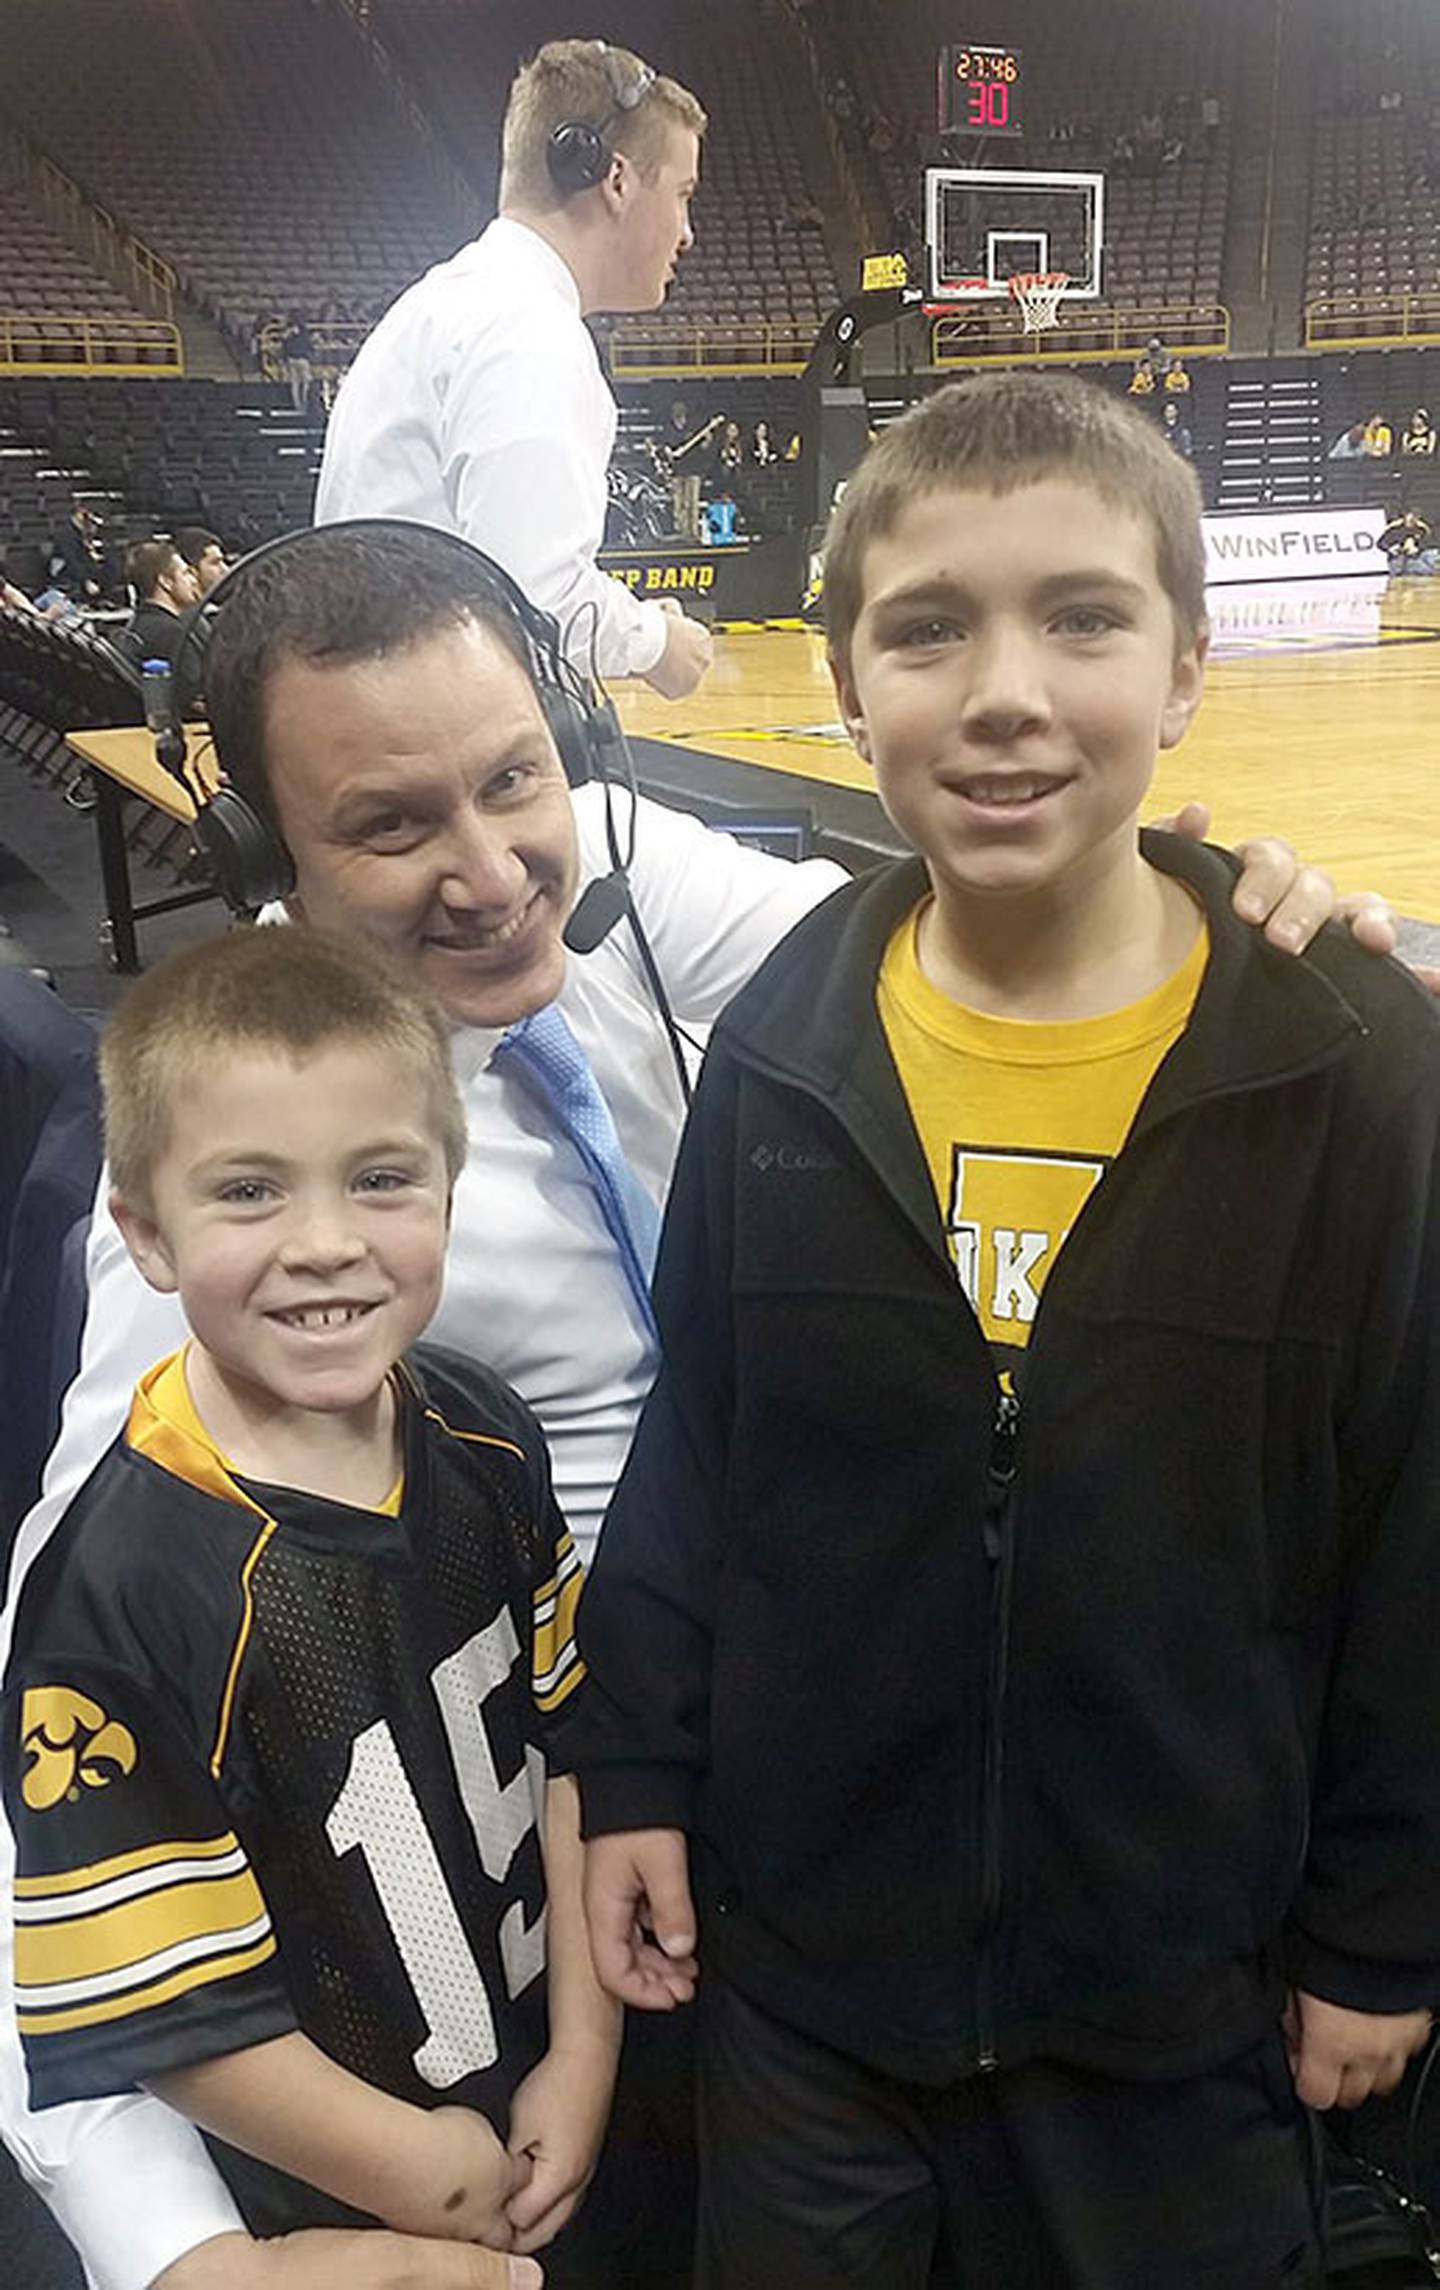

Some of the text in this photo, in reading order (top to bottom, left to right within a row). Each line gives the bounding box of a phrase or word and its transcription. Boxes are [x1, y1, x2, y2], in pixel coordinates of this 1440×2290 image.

[957, 53, 1017, 82] 27:46
[968, 81, 1008, 126] 30
[645, 565, 714, 589] BAND
[324, 1602, 547, 2090] 15
